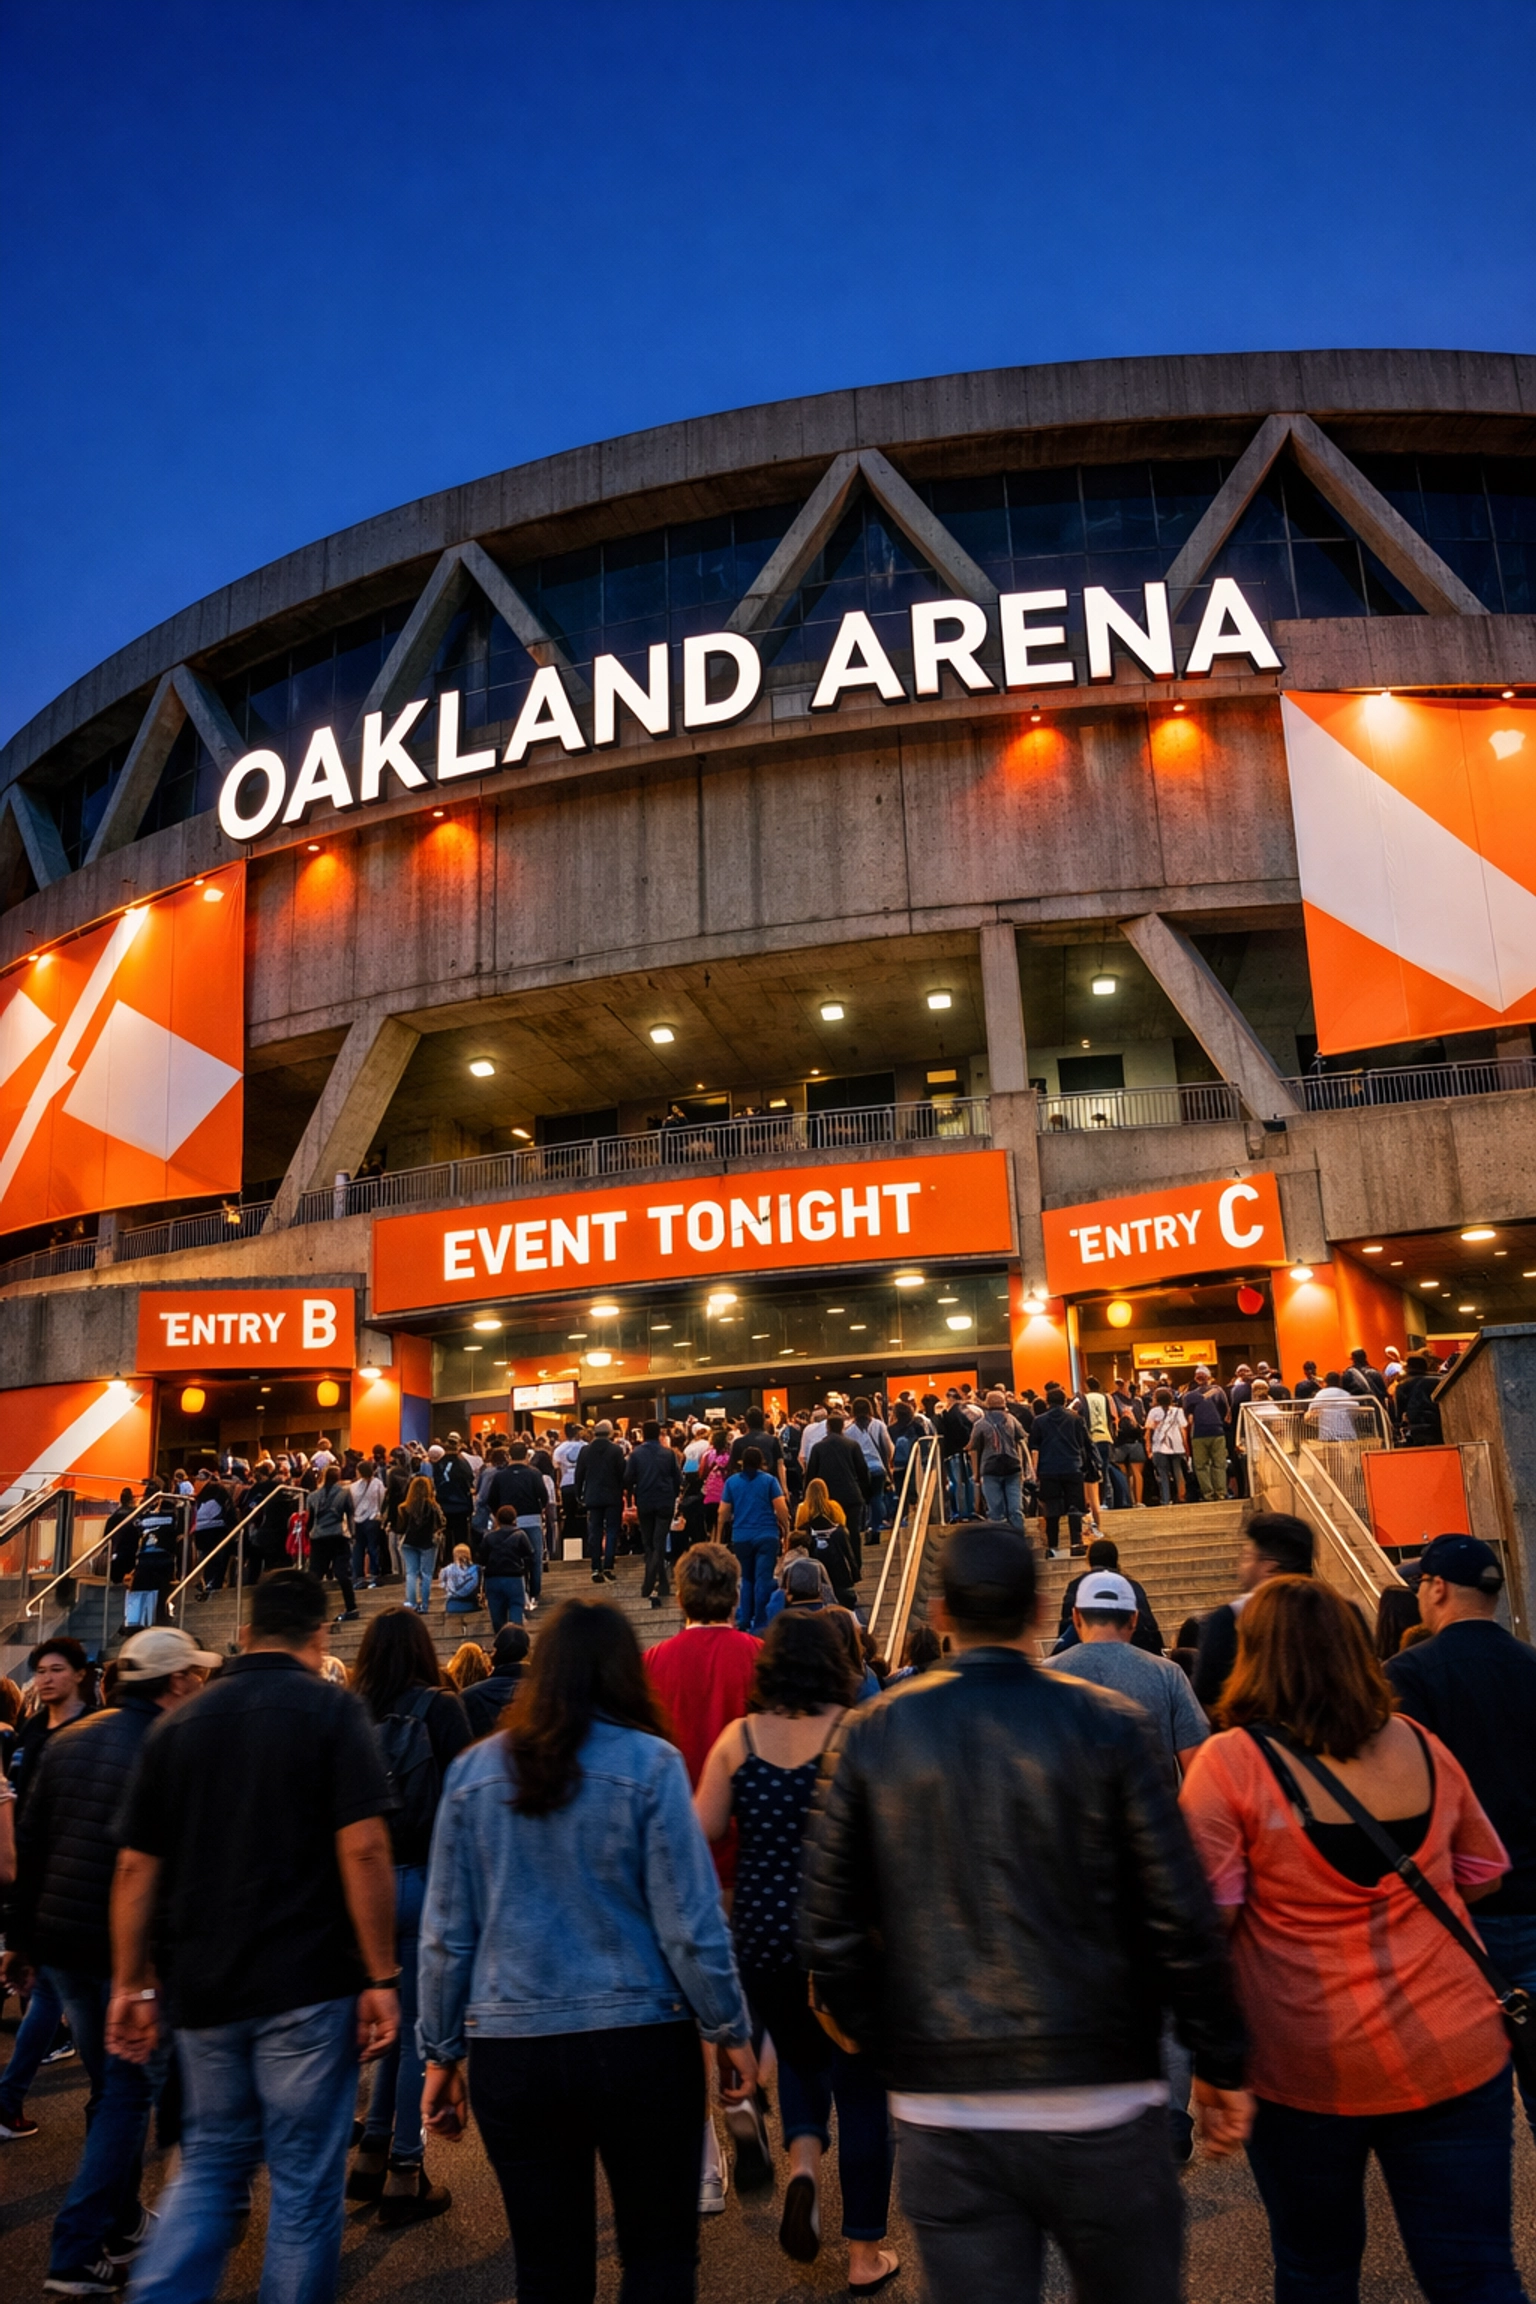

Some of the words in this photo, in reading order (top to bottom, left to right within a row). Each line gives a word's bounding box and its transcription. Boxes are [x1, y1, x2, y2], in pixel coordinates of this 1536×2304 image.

[217, 632, 761, 841] OAKLAND
[810, 577, 1284, 708] ARENA
[444, 1211, 627, 1281] EVENT
[647, 1182, 921, 1256] TONIGHT
[1070, 1209, 1202, 1264] ENTRY
[1218, 1183, 1264, 1248] C
[159, 1312, 286, 1347] ENTRY
[303, 1299, 337, 1349] B
